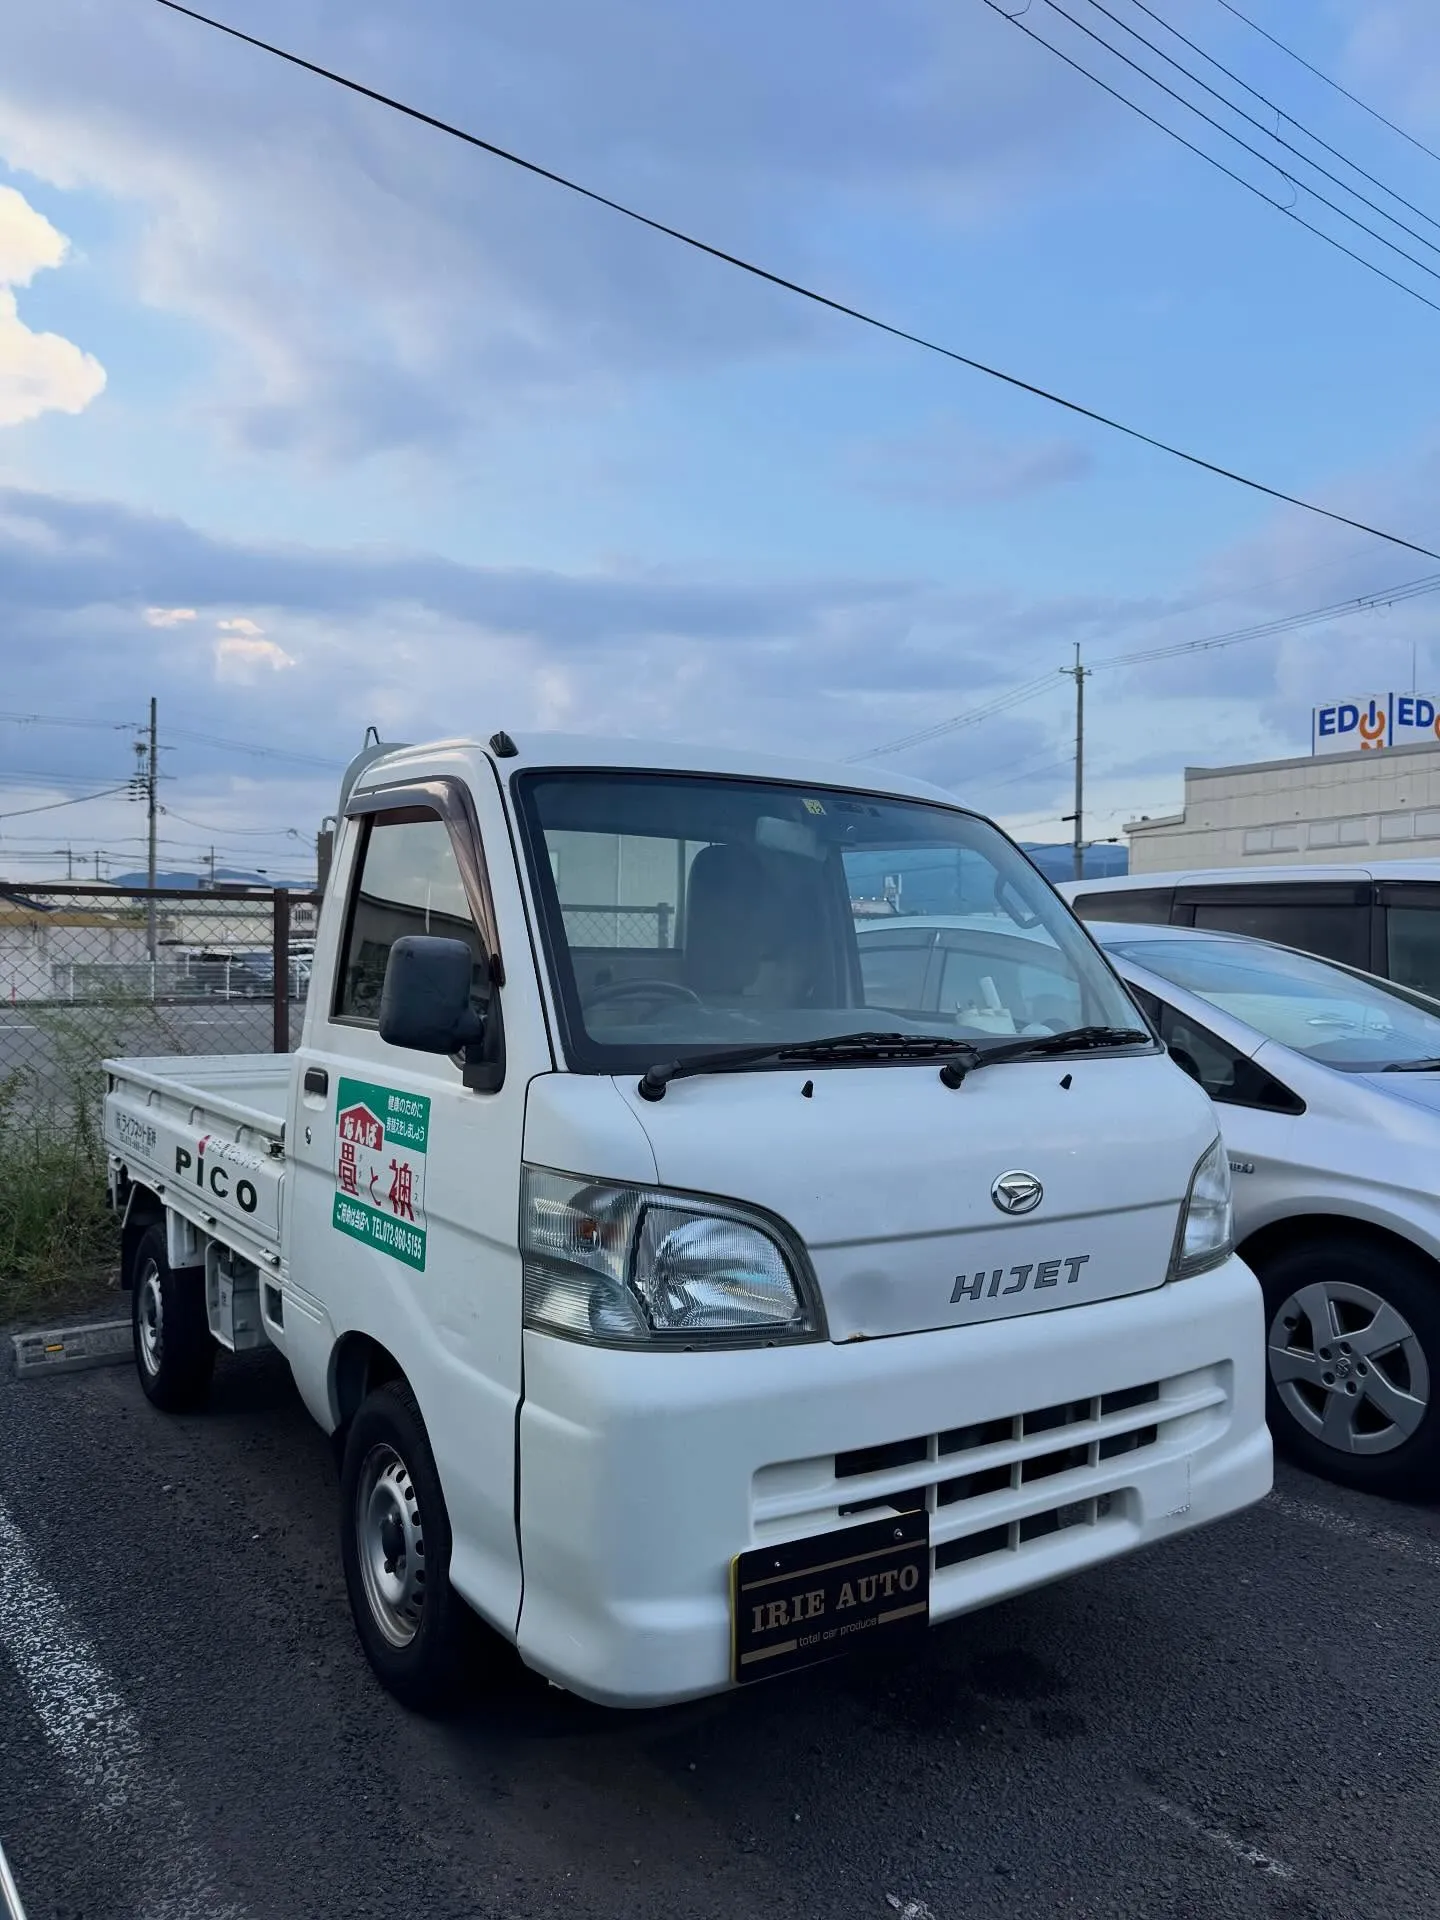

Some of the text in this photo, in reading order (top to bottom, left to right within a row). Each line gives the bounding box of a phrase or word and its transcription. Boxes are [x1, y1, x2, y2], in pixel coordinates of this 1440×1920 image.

[387, 1095, 424, 1119] 健康のために
[343, 1116, 379, 1149] なんば
[950, 1255, 1090, 1304] HIJET
[751, 1564, 919, 1633] IRIE AUTO
[799, 1616, 878, 1647] total car produce
